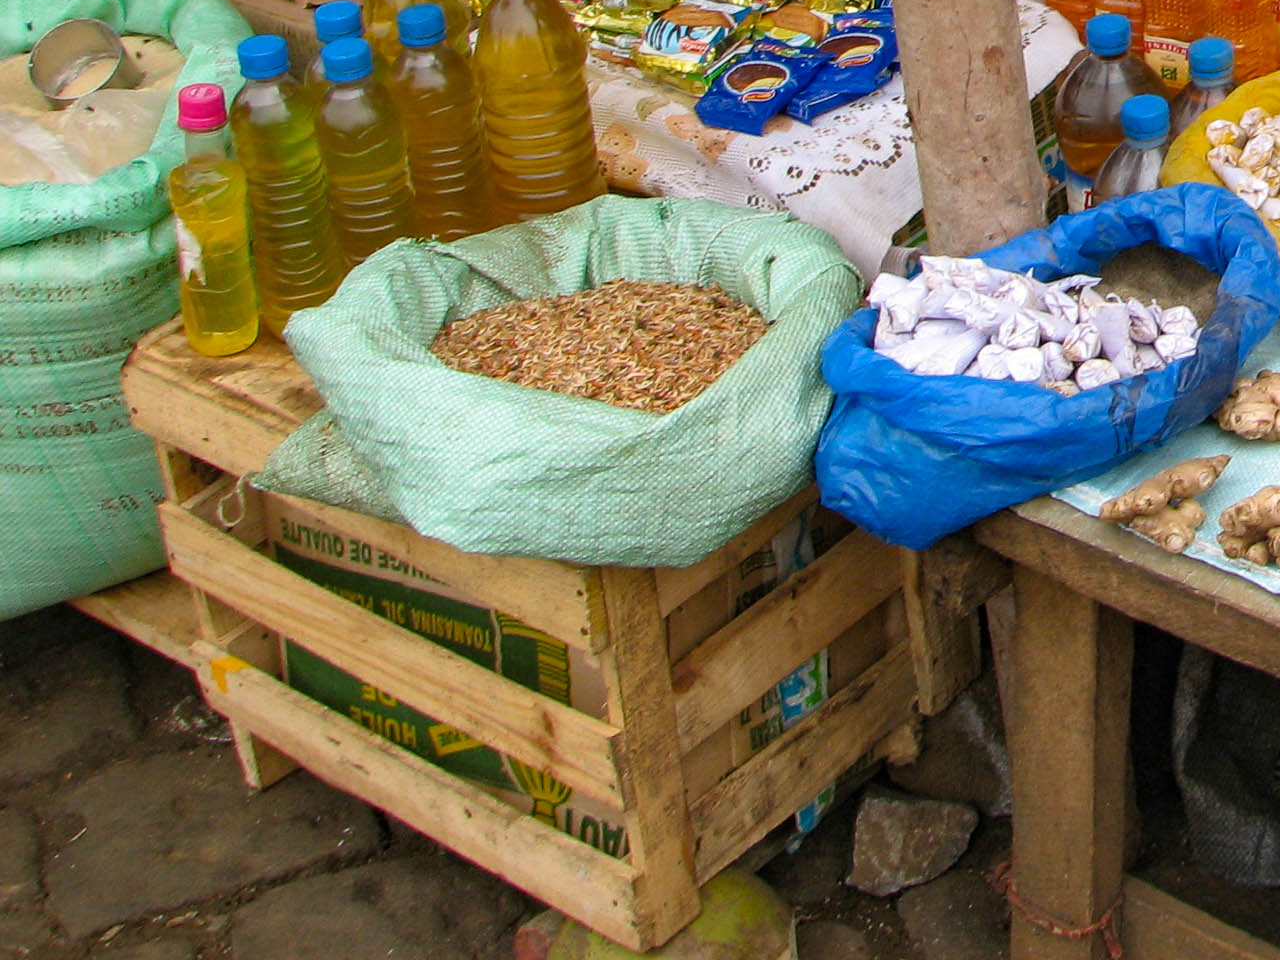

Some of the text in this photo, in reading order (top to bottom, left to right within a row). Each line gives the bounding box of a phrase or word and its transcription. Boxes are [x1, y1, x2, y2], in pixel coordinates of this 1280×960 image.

[279, 517, 372, 566] DE QUALITE
[412, 608, 494, 653] TOAMASINA
[348, 705, 417, 749] HUILE
